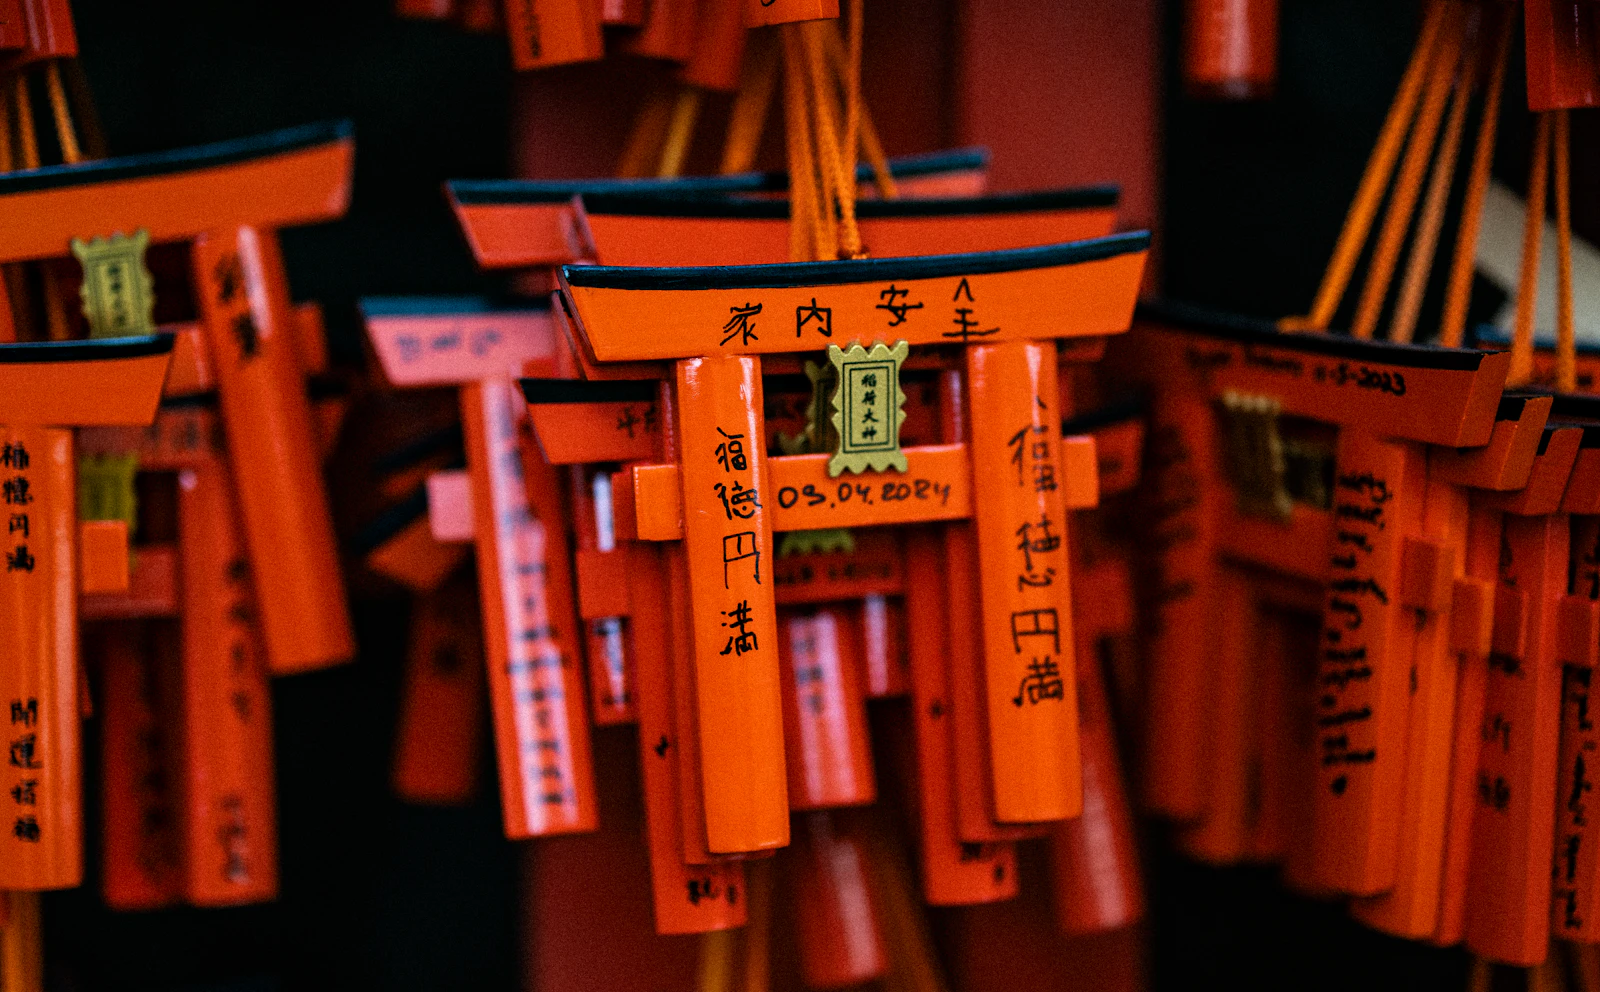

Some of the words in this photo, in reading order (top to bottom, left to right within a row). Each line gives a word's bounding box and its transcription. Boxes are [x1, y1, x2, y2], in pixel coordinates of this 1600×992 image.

[720, 278, 1000, 346] 家内安全
[861, 373, 879, 441] 稲荷大神
